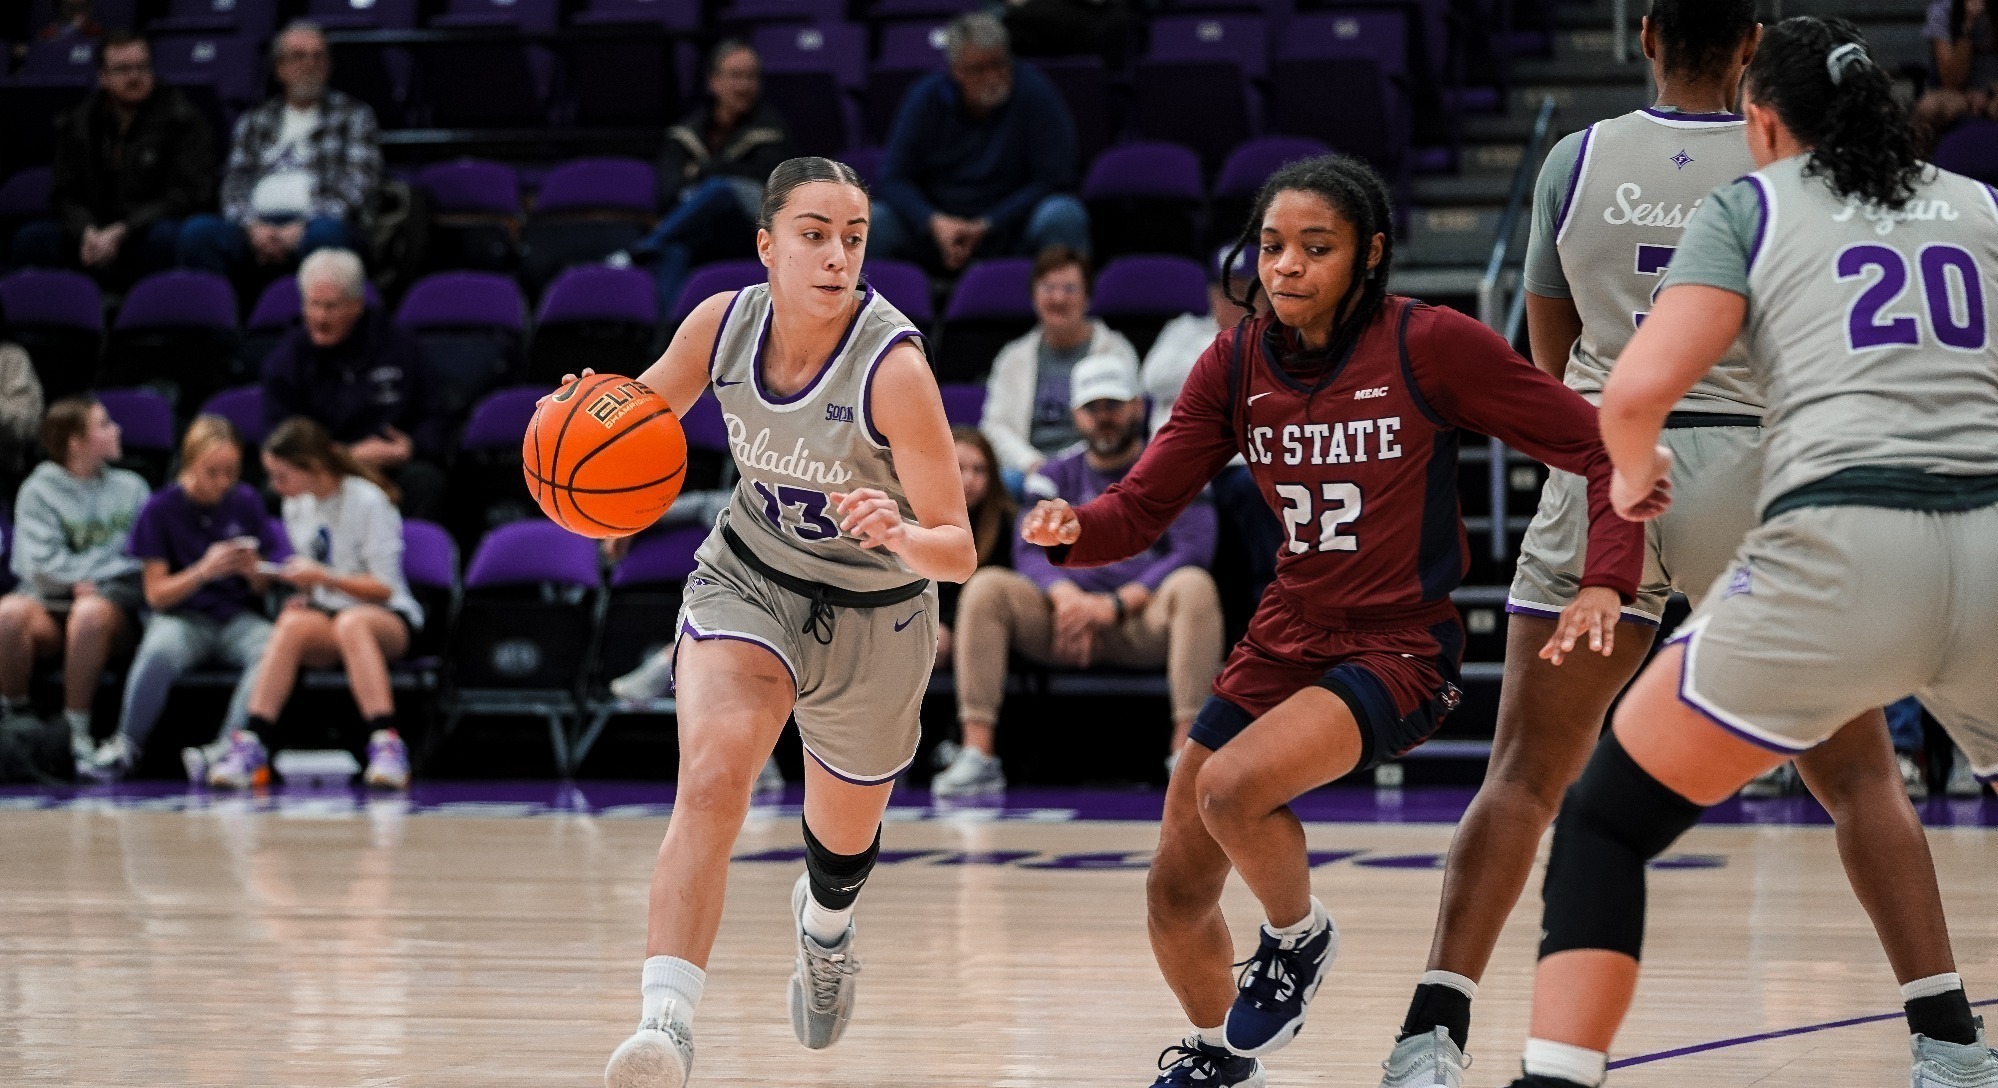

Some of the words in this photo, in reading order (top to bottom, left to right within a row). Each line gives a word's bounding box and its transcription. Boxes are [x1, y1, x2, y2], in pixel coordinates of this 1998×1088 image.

[1836, 241, 1988, 354] 20
[586, 381, 656, 424] ELITE
[1353, 386, 1389, 400] MEAC
[724, 413, 852, 484] Paladins
[1282, 416, 1402, 465] STATE
[751, 478, 842, 543] 13
[1275, 482, 1362, 554] 22
